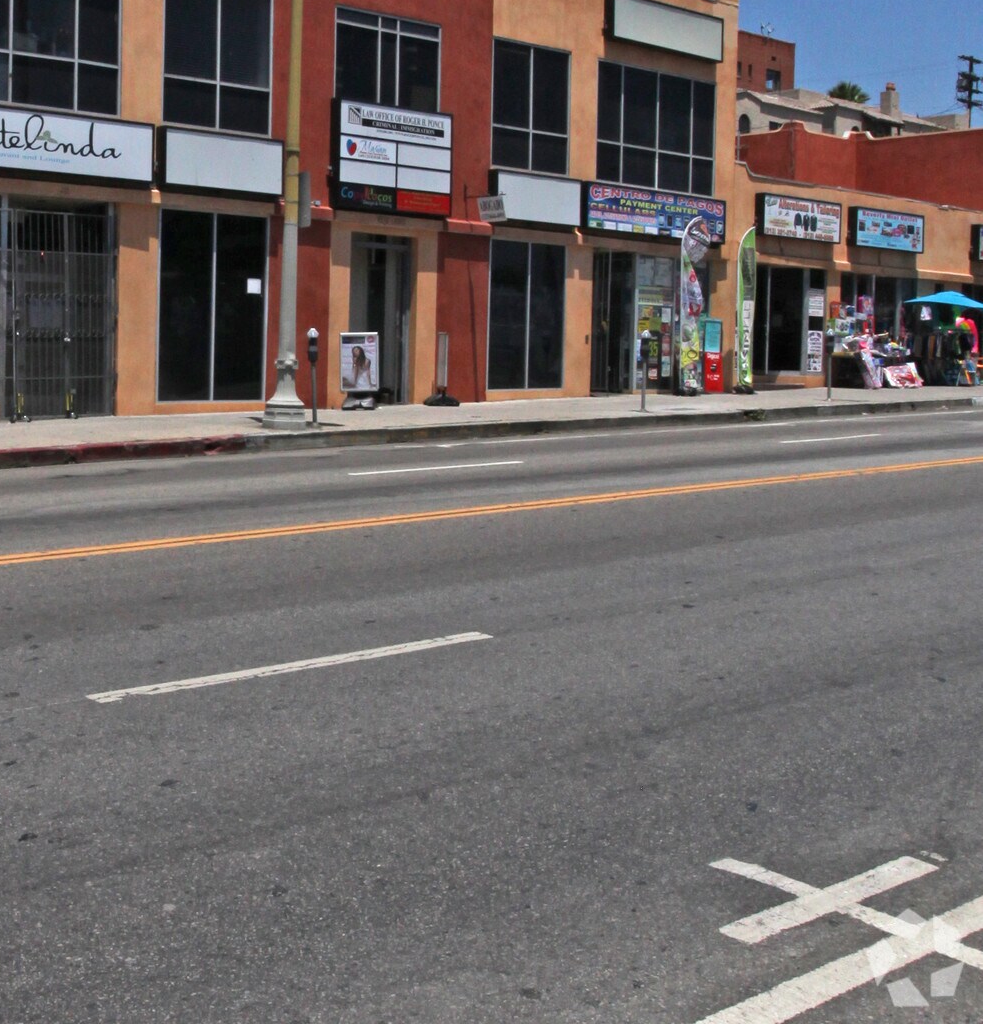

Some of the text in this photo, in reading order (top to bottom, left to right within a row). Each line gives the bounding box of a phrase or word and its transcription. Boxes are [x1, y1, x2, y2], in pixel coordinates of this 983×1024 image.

[375, 111, 394, 122] OFFICE
[395, 114, 402, 123] OF
[591, 184, 723, 217] CENTRO DE PAGOS
[620, 198, 699, 216] PAYMENT CENTER
